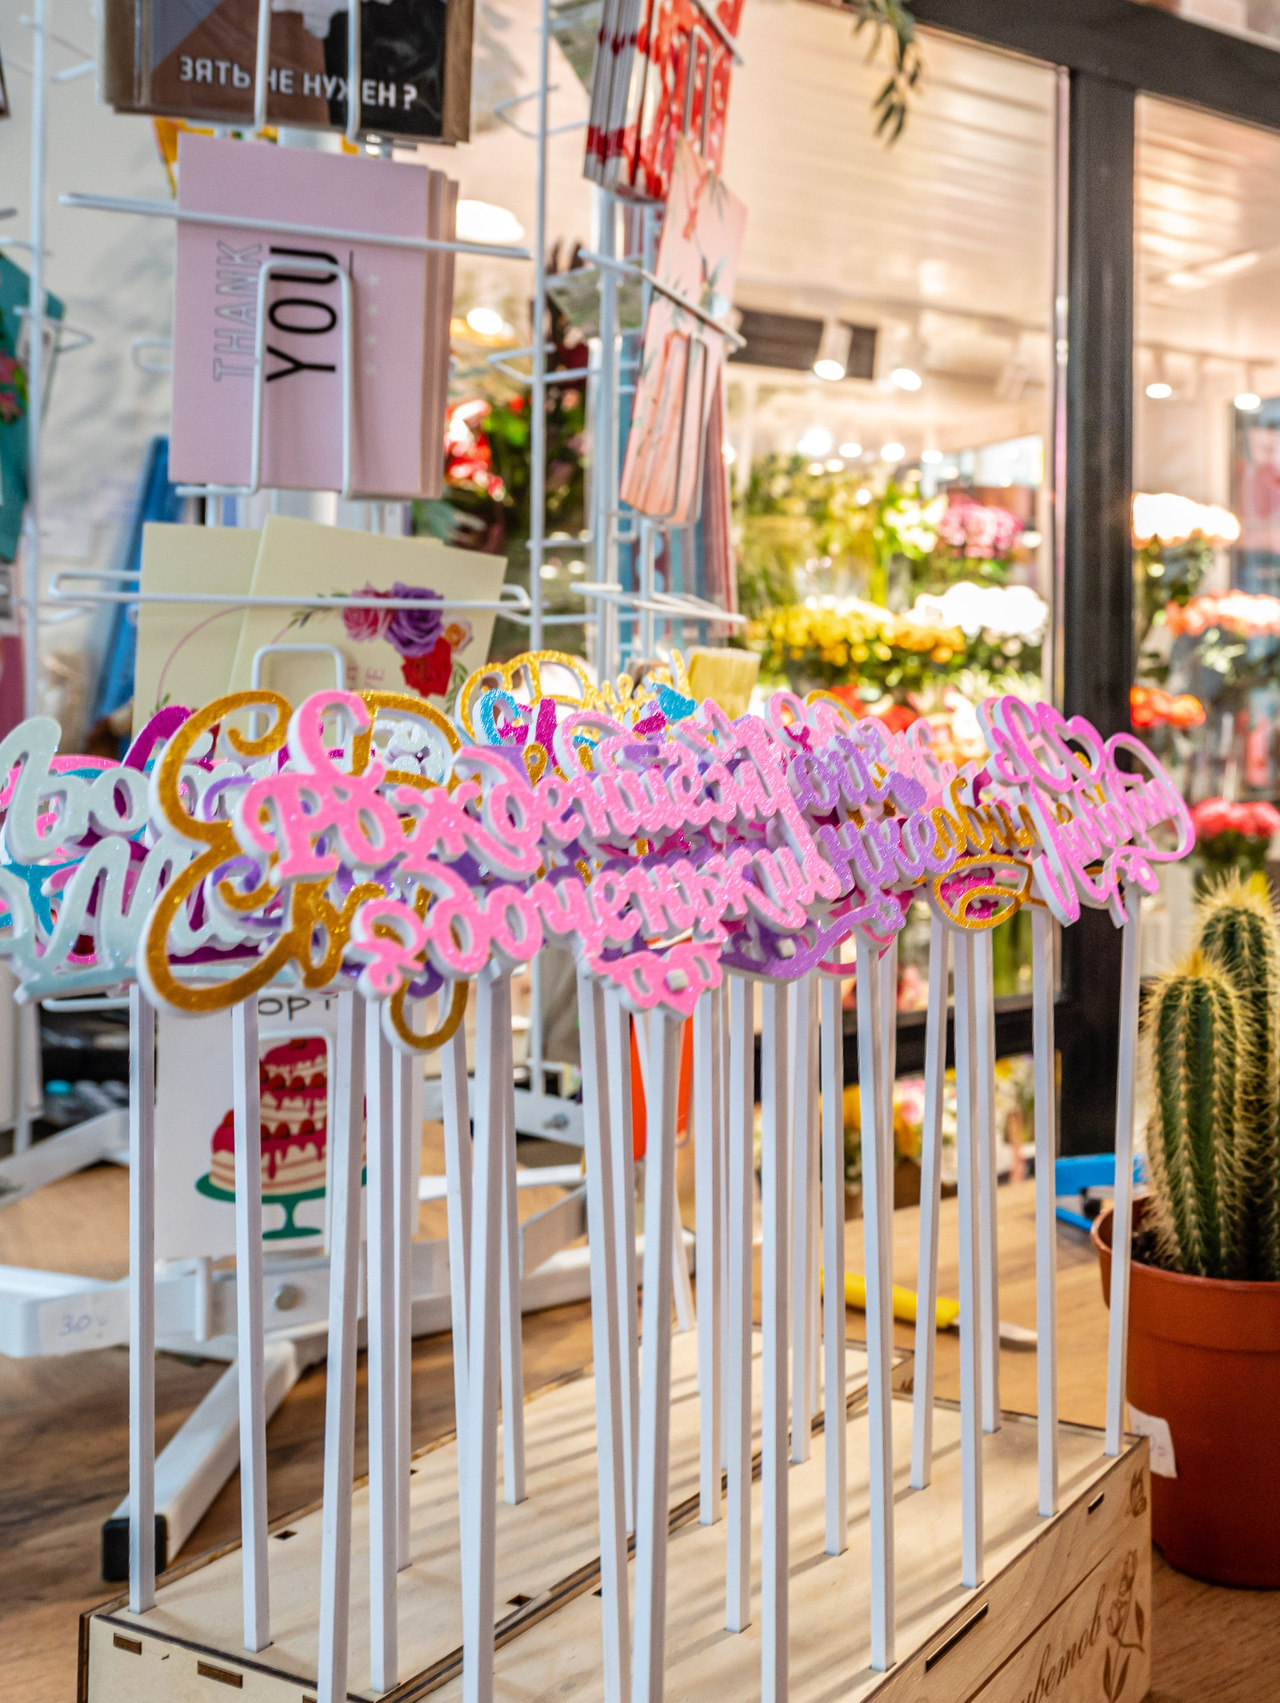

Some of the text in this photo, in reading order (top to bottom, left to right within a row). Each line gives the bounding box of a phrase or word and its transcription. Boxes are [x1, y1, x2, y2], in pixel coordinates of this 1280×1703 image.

[179, 55, 251, 89] ЗЯТЬ
[265, 68, 294, 95] НЕ
[212, 240, 262, 383] THANK
[265, 246, 339, 382] YOU
